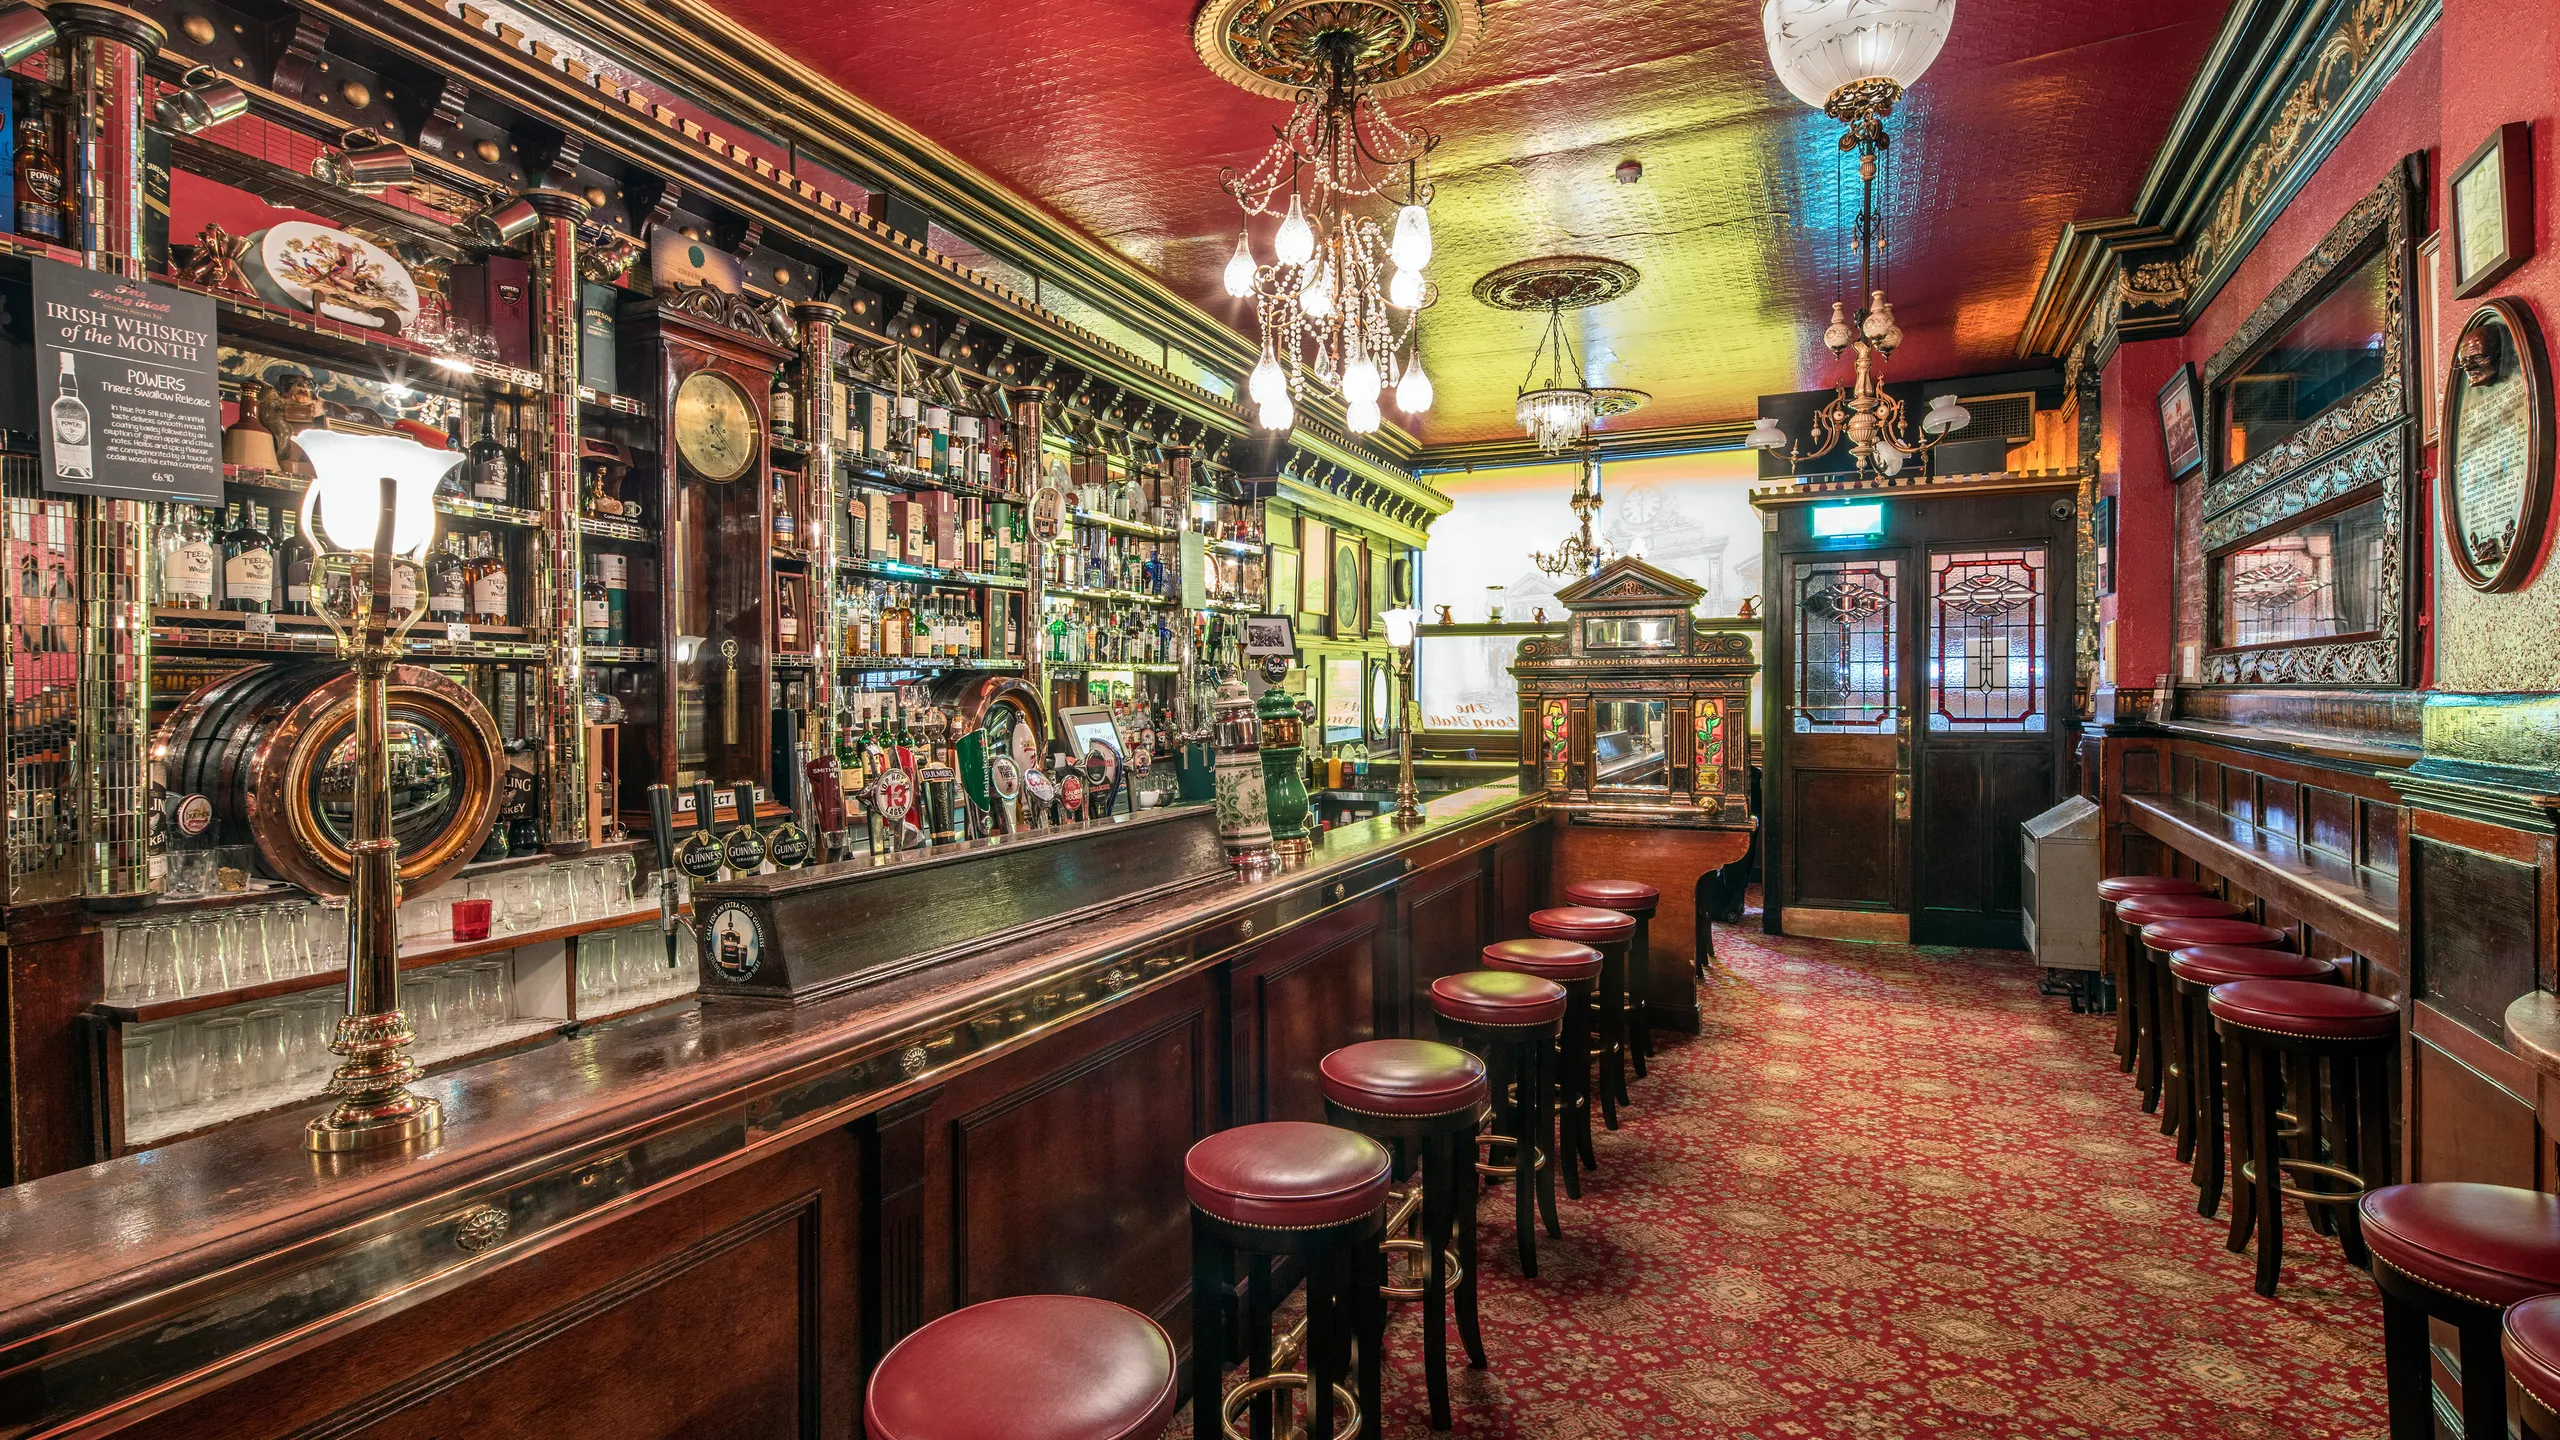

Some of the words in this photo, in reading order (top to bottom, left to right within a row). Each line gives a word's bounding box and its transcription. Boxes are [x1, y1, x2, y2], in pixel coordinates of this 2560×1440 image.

[30, 171, 61, 187] POWERS
[147, 162, 169, 182] JAMESON
[500, 284, 519, 293] POWERS
[88, 288, 133, 307] Long
[135, 299, 171, 313] Hall
[585, 309, 612, 323] JAMESON
[46, 302, 107, 328] IRISH
[113, 315, 208, 348] WHISKEY
[61, 325, 82, 343] of
[84, 328, 112, 345] the
[117, 333, 198, 361] MONTH
[127, 369, 186, 392] POWERS
[101, 381, 132, 395] Three
[134, 387, 174, 402] Swallow
[175, 393, 211, 408] Release
[61, 420, 83, 429] POWERS
[111, 421, 138, 432] coating
[161, 427, 187, 437] followed
[188, 430, 197, 440] by
[157, 419, 183, 428] smooth
[184, 423, 206, 432] mouth
[103, 428, 133, 438] eruption
[143, 434, 163, 442] green
[164, 436, 180, 444] apple
[120, 446, 171, 458] complemented
[171, 452, 180, 461] by
[186, 454, 205, 462] touch
[133, 440, 153, 448] Herbs
[154, 442, 168, 450] and
[168, 444, 185, 454] spicy
[128, 455, 147, 463] wood
[152, 472, 174, 483] €6.90
[999, 557, 1009, 567] 12
[922, 769, 954, 779] BULMERS
[881, 777, 890, 795] HOP
[685, 794, 731, 808] COECT
[884, 784, 907, 807] 13
[885, 805, 906, 816] LAGER
[728, 844, 764, 857] GUINNESS
[774, 842, 807, 855] GUINNESS
[684, 850, 723, 865] GUINNESS
[781, 852, 803, 860] DRAUGHT
[692, 862, 718, 870] DRAUGHT
[709, 912, 717, 925] FOR
[717, 904, 724, 915] AN
[724, 901, 740, 910] EXTRA
[740, 904, 754, 917] COLD
[753, 916, 765, 948] GUINNESS
[729, 971, 753, 983] INSTALLED
[751, 960, 762, 975] HERE
